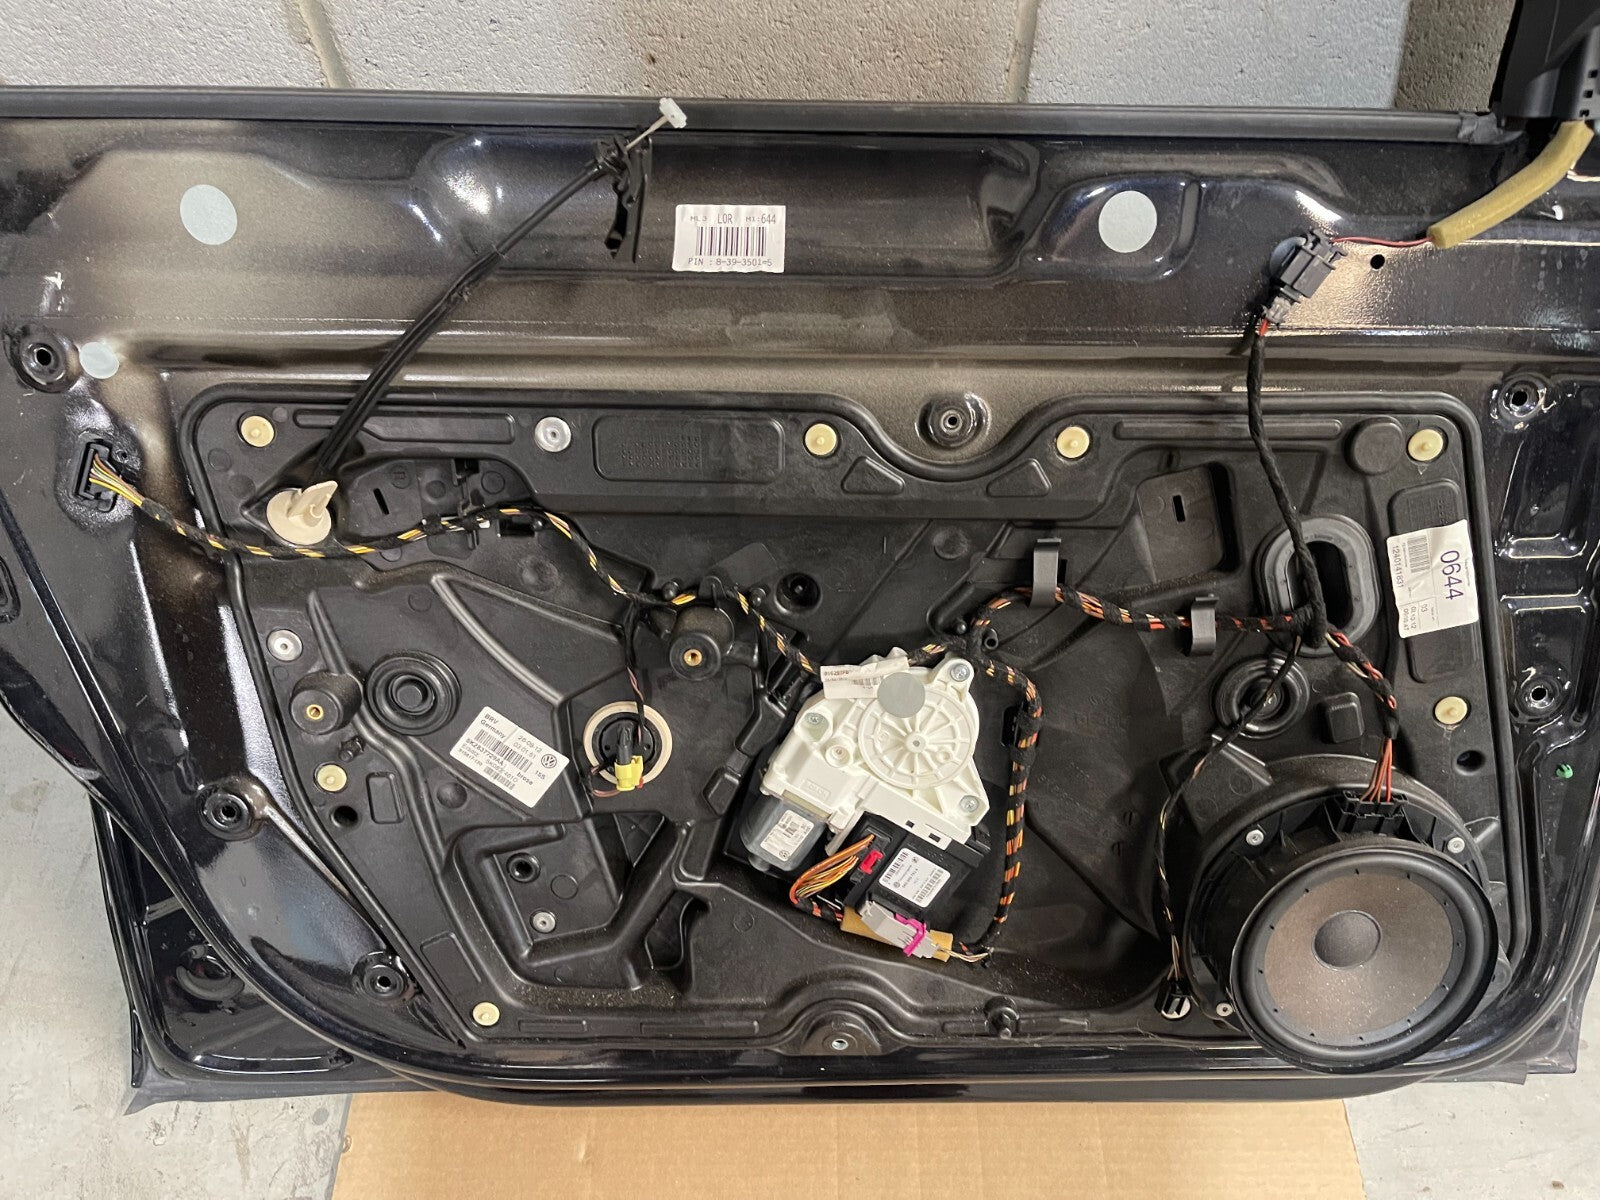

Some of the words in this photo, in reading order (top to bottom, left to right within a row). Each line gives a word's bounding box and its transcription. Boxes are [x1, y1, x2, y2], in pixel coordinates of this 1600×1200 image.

[687, 257, 704, 265] PIN
[1440, 550, 1464, 600] 0644
[484, 713, 499, 724] BRV
[480, 719, 506, 738] Germany
[516, 772, 533, 785] brose
